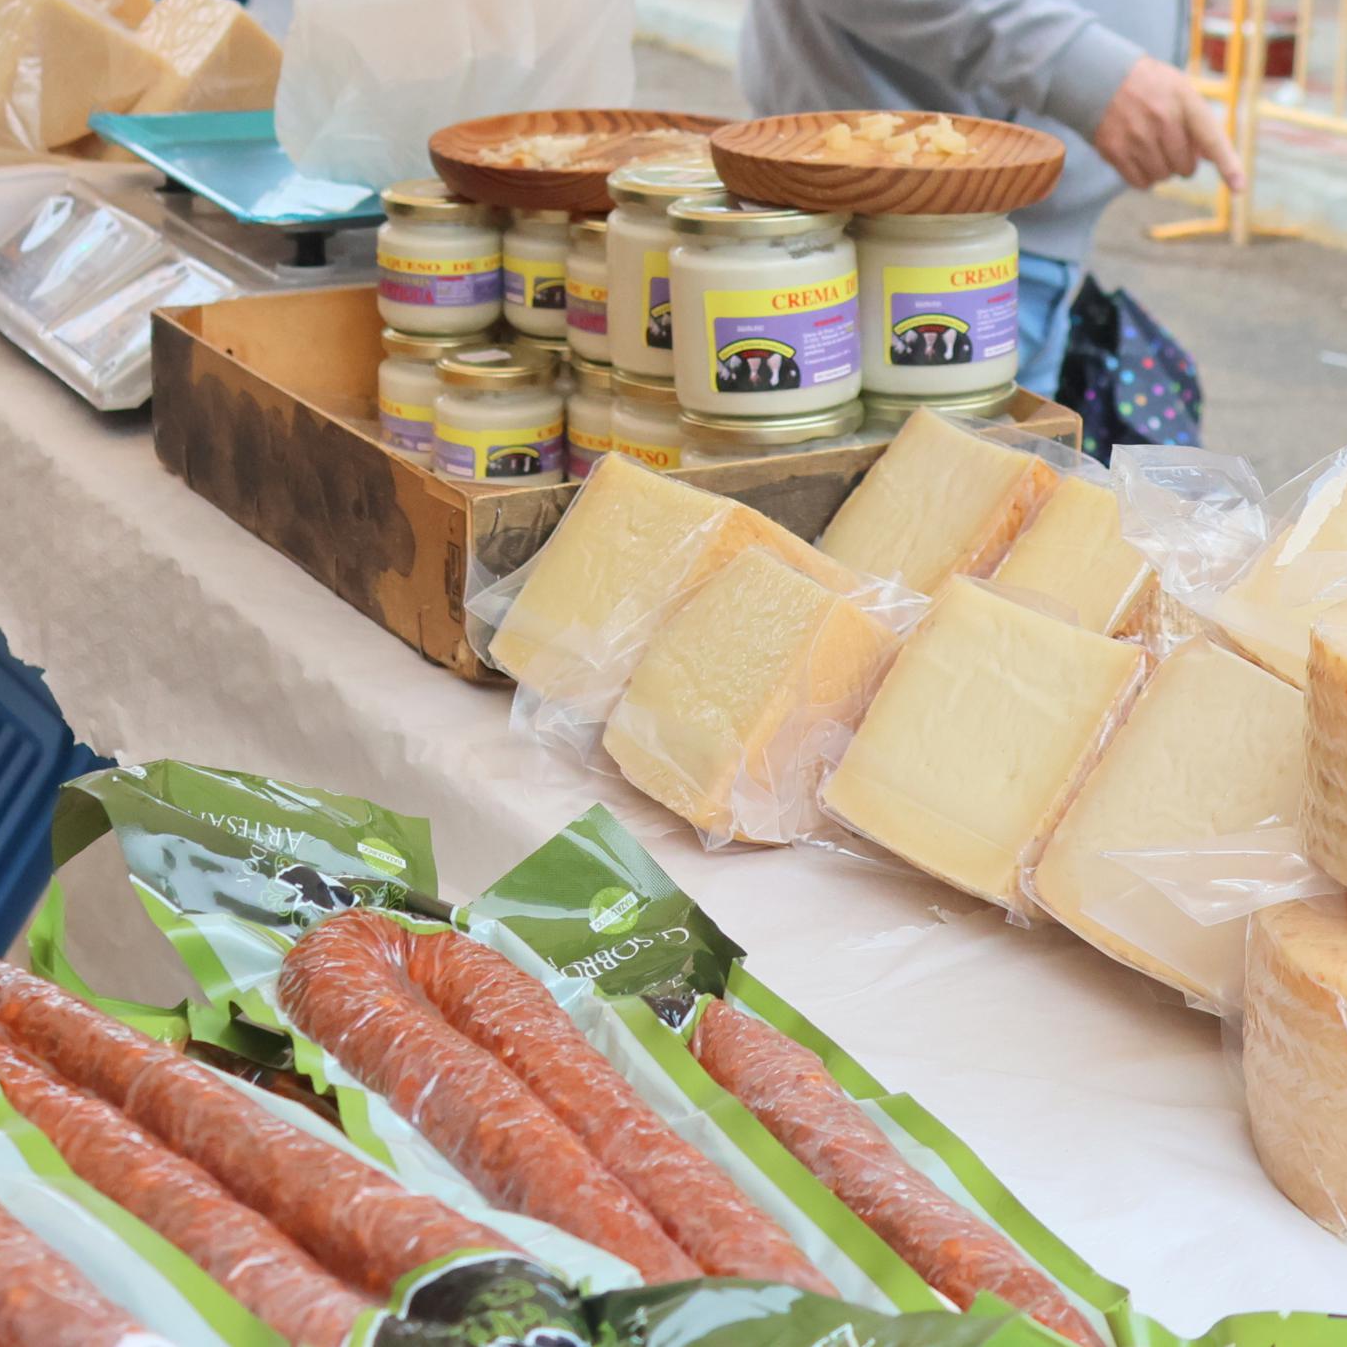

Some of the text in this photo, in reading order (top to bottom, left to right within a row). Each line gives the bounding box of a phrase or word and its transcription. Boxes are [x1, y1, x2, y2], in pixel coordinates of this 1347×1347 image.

[950, 263, 1011, 287] CREMA
[771, 284, 840, 311] CREMA
[199, 811, 306, 853] ARTESA
